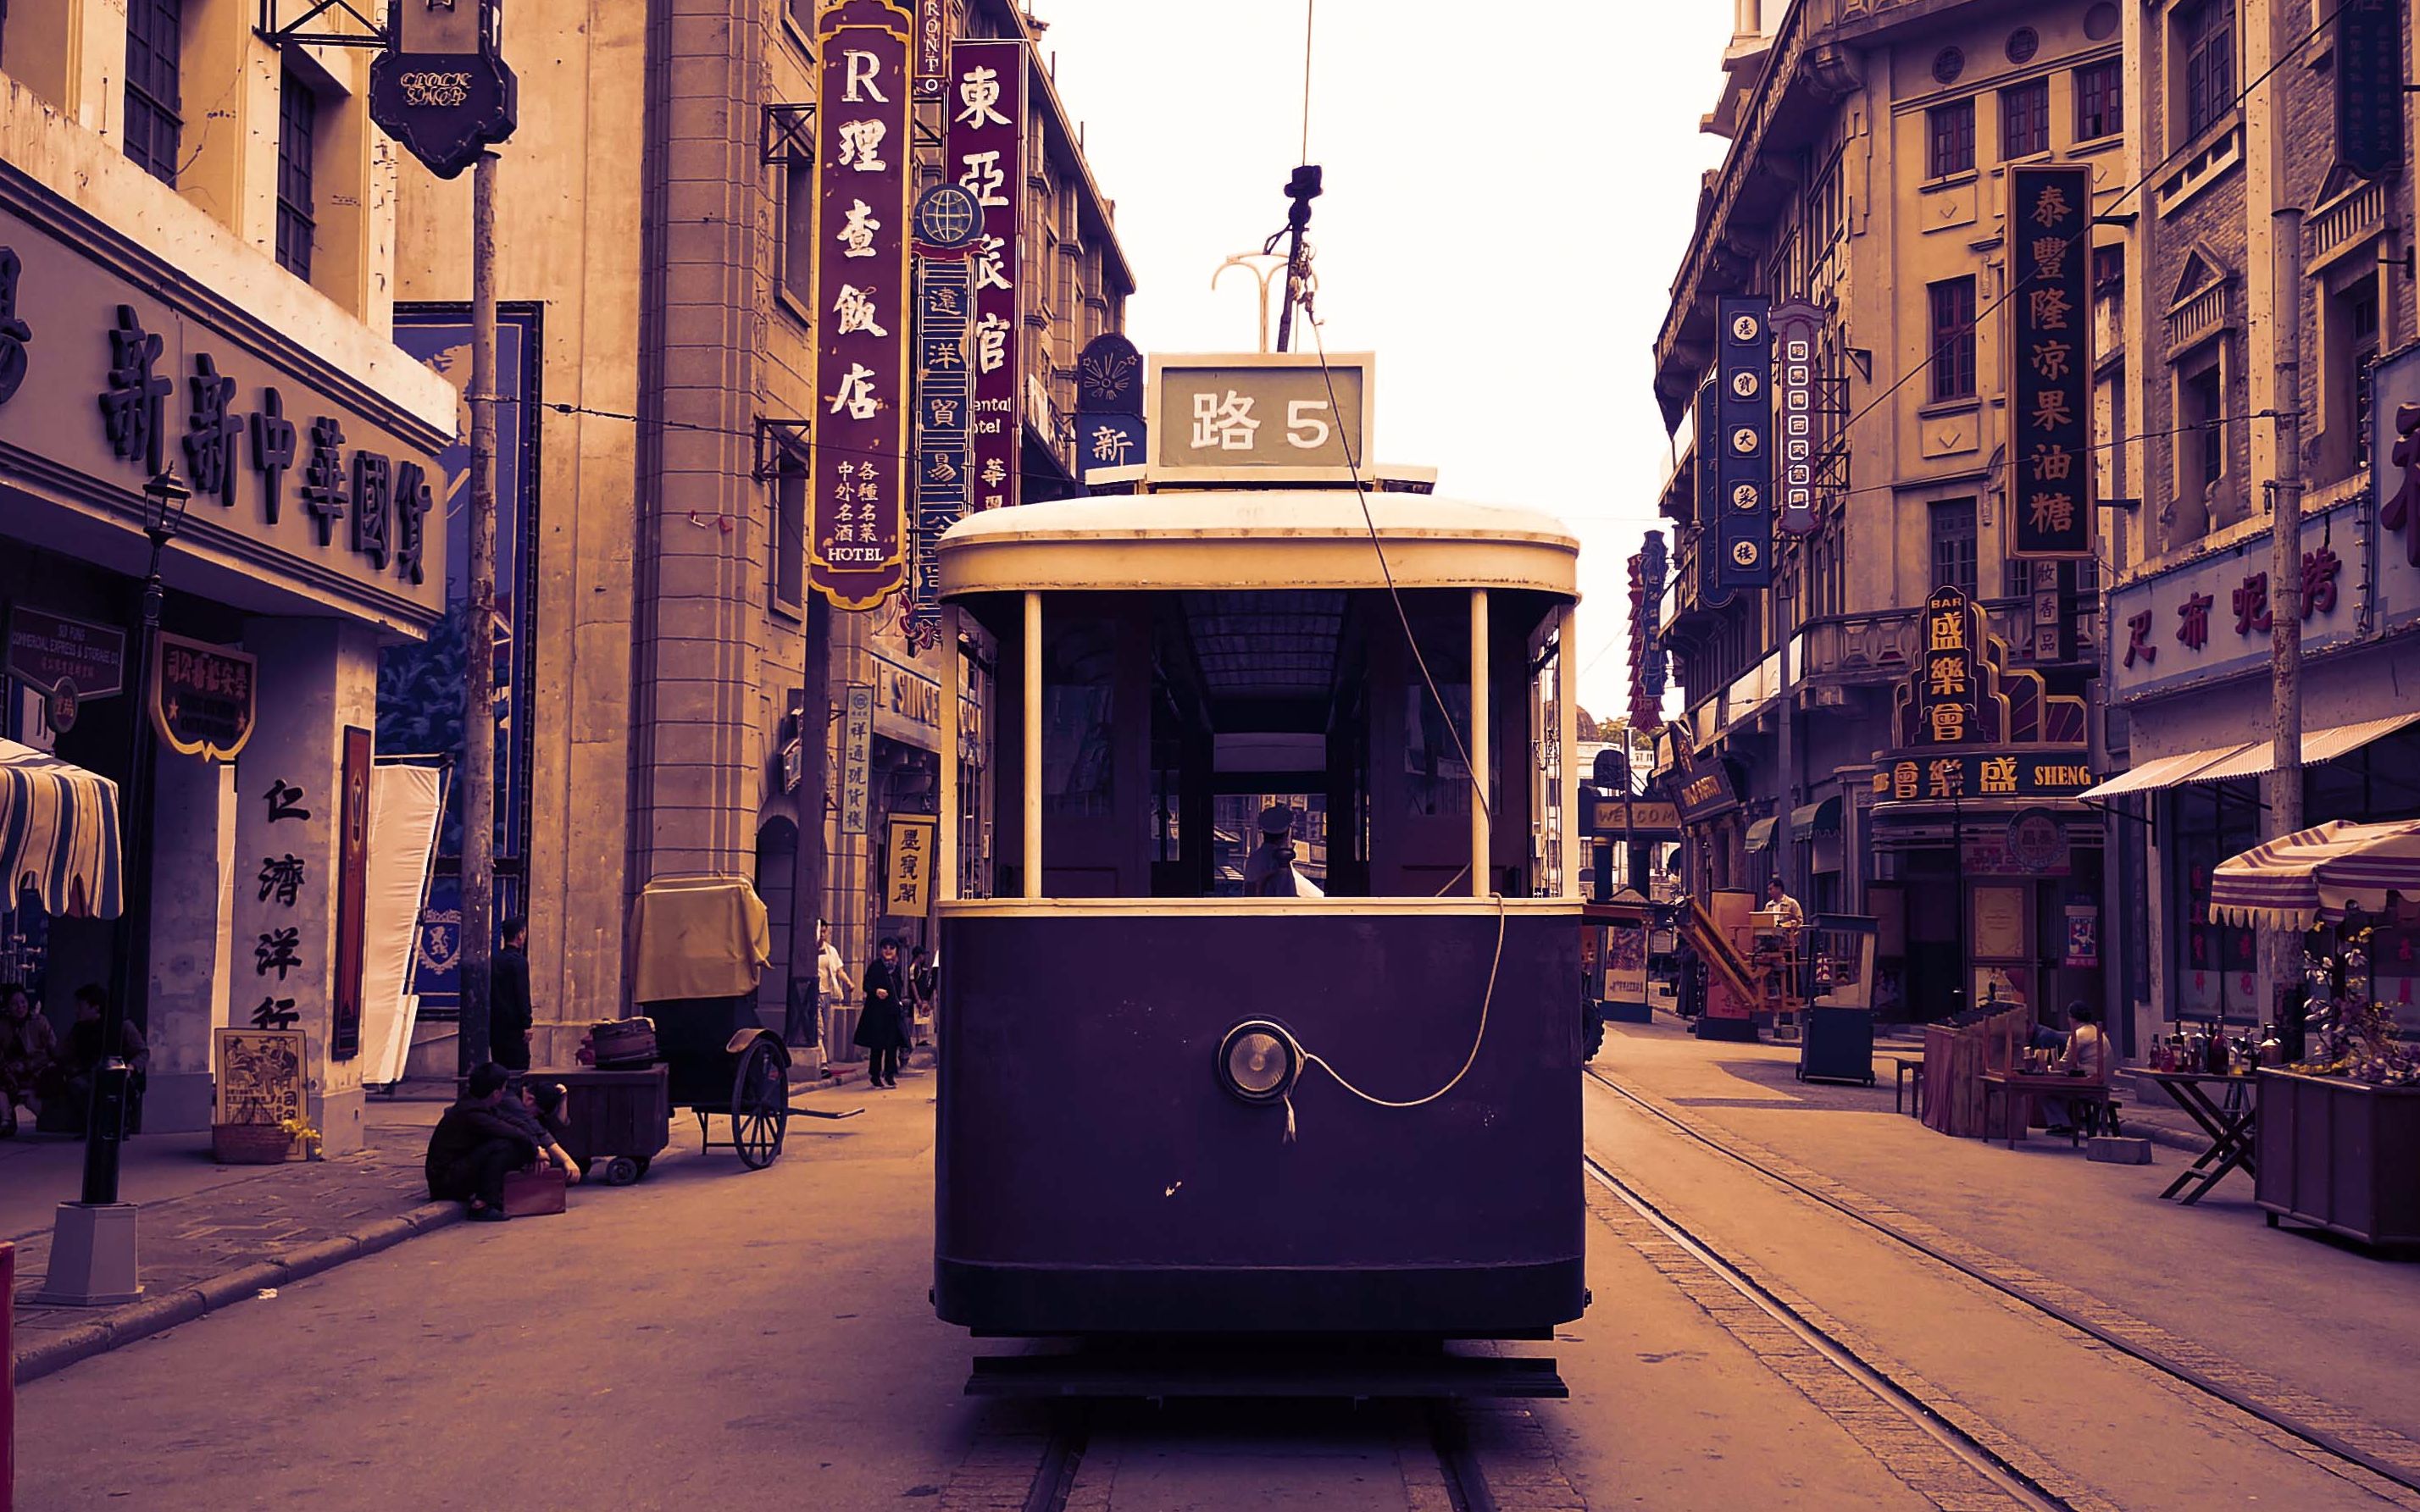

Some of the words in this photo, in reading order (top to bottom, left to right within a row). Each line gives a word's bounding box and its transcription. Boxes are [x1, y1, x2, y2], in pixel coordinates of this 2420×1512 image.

[401, 72, 473, 89] CLOCK
[973, 396, 1012, 413] ental
[1286, 400, 1329, 449] 5
[828, 547, 885, 562] HOTEL
[1931, 598, 1962, 609] BAR
[2034, 765, 2091, 786] SHENG
